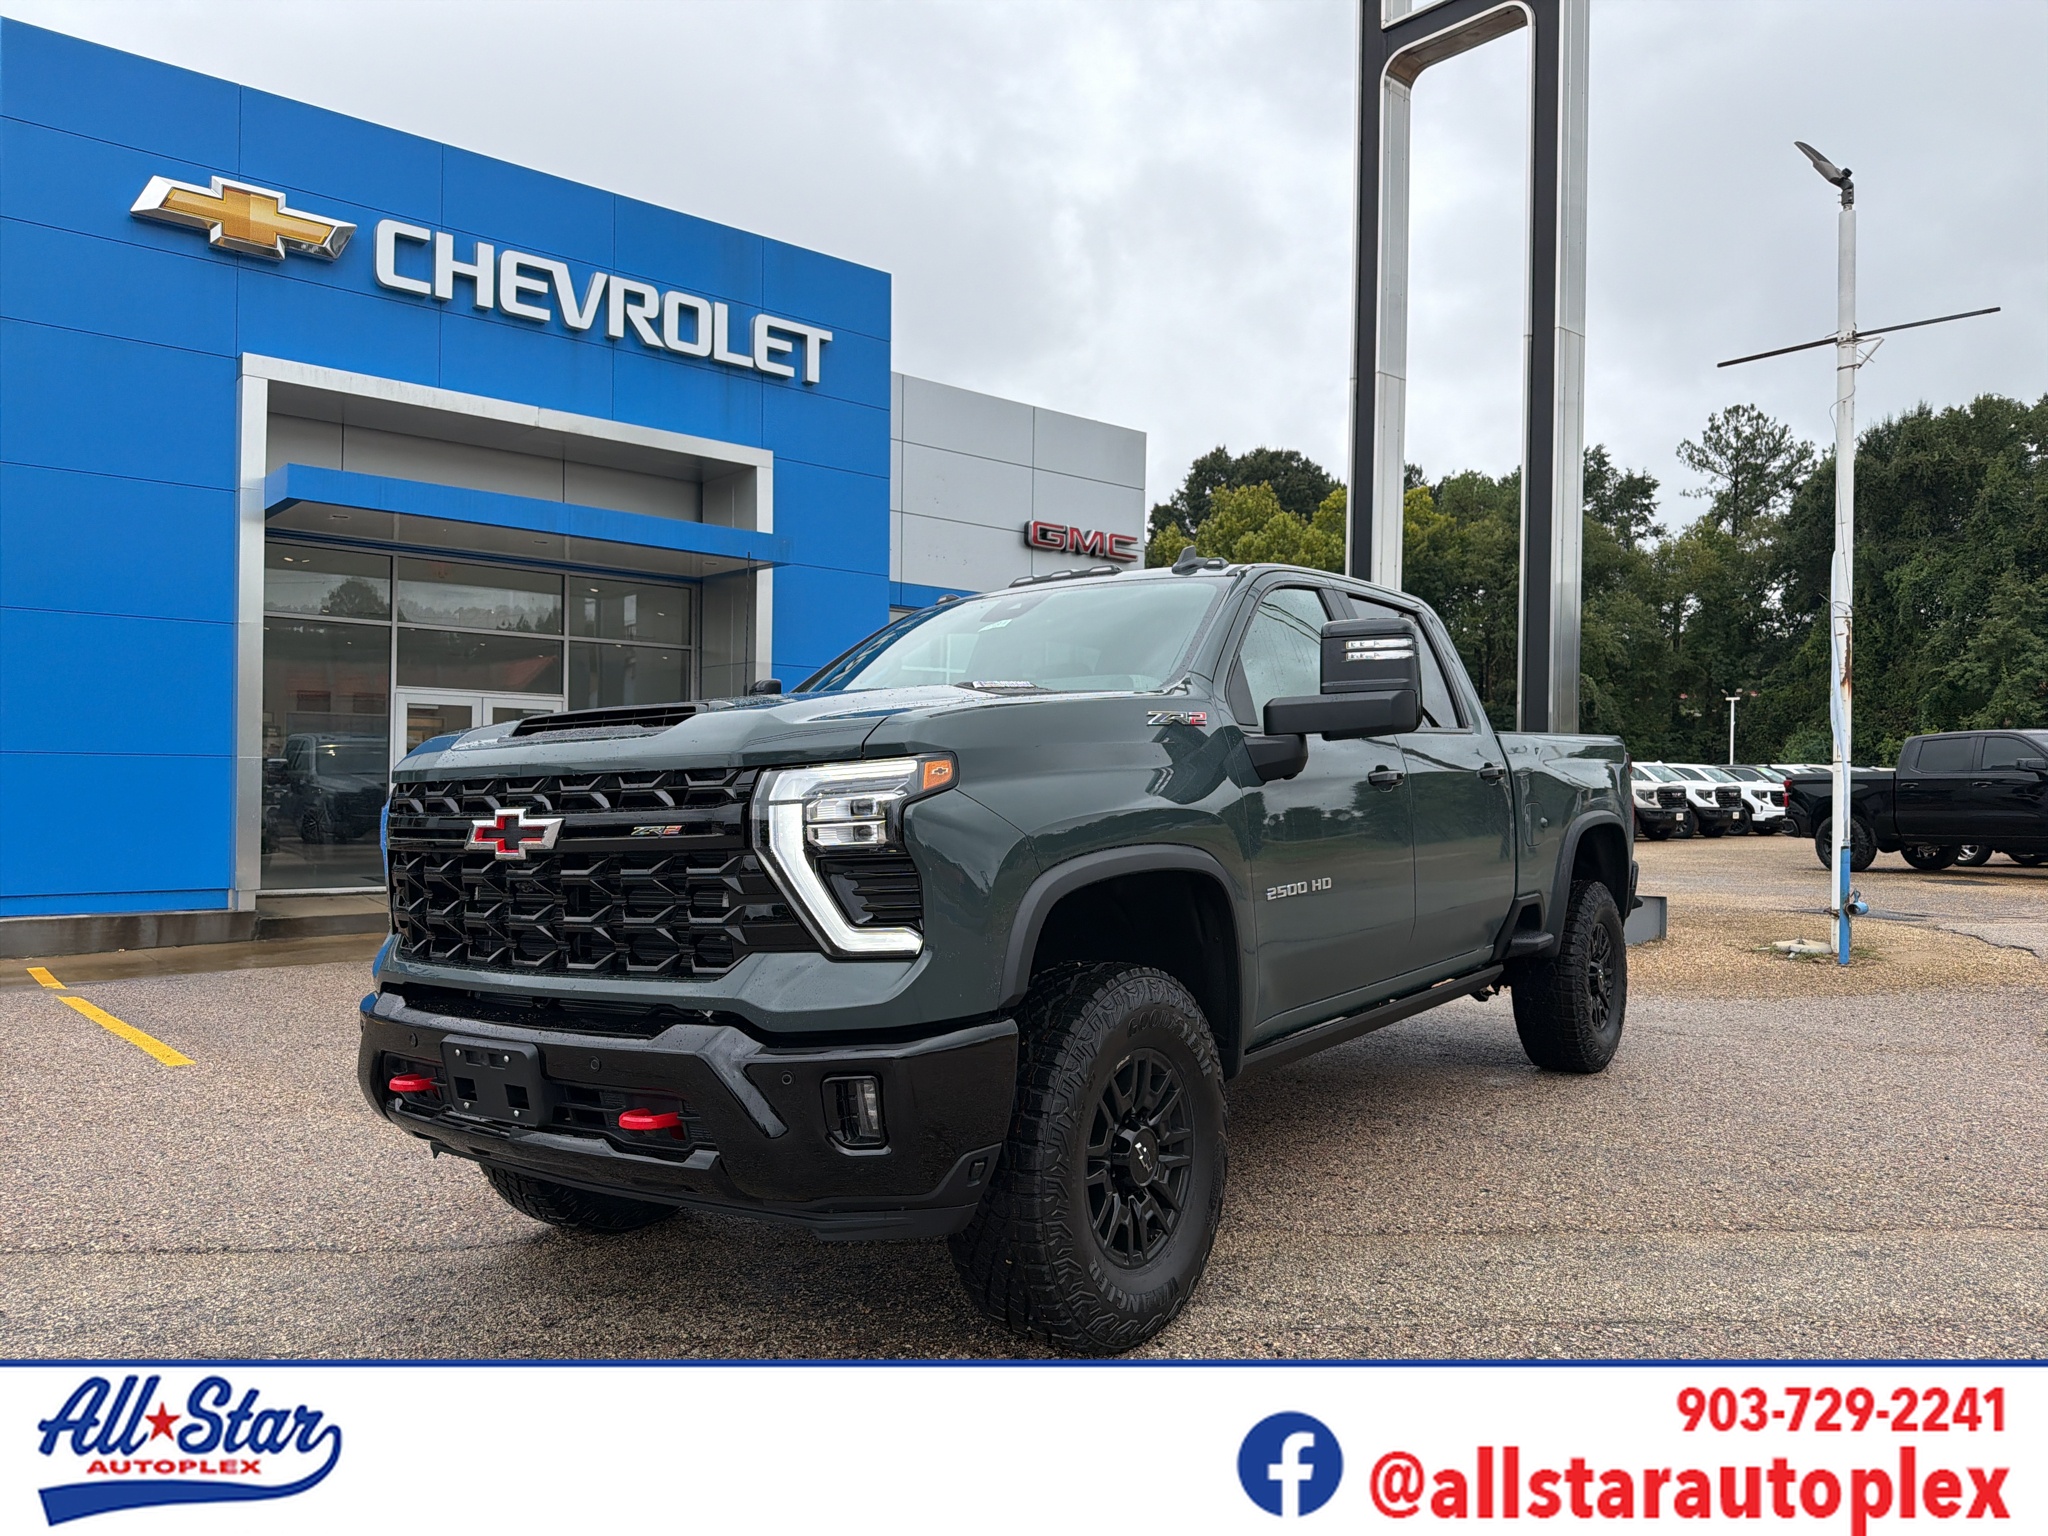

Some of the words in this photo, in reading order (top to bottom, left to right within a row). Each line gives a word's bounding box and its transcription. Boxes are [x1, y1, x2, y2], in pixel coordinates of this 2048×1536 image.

[374, 218, 834, 386] CHEVROLET
[1024, 519, 1139, 563] GMC
[1146, 710, 1208, 727] ZR2
[630, 824, 684, 838] ZR2
[1265, 881, 1308, 902] 2500
[1310, 876, 1333, 893] HD
